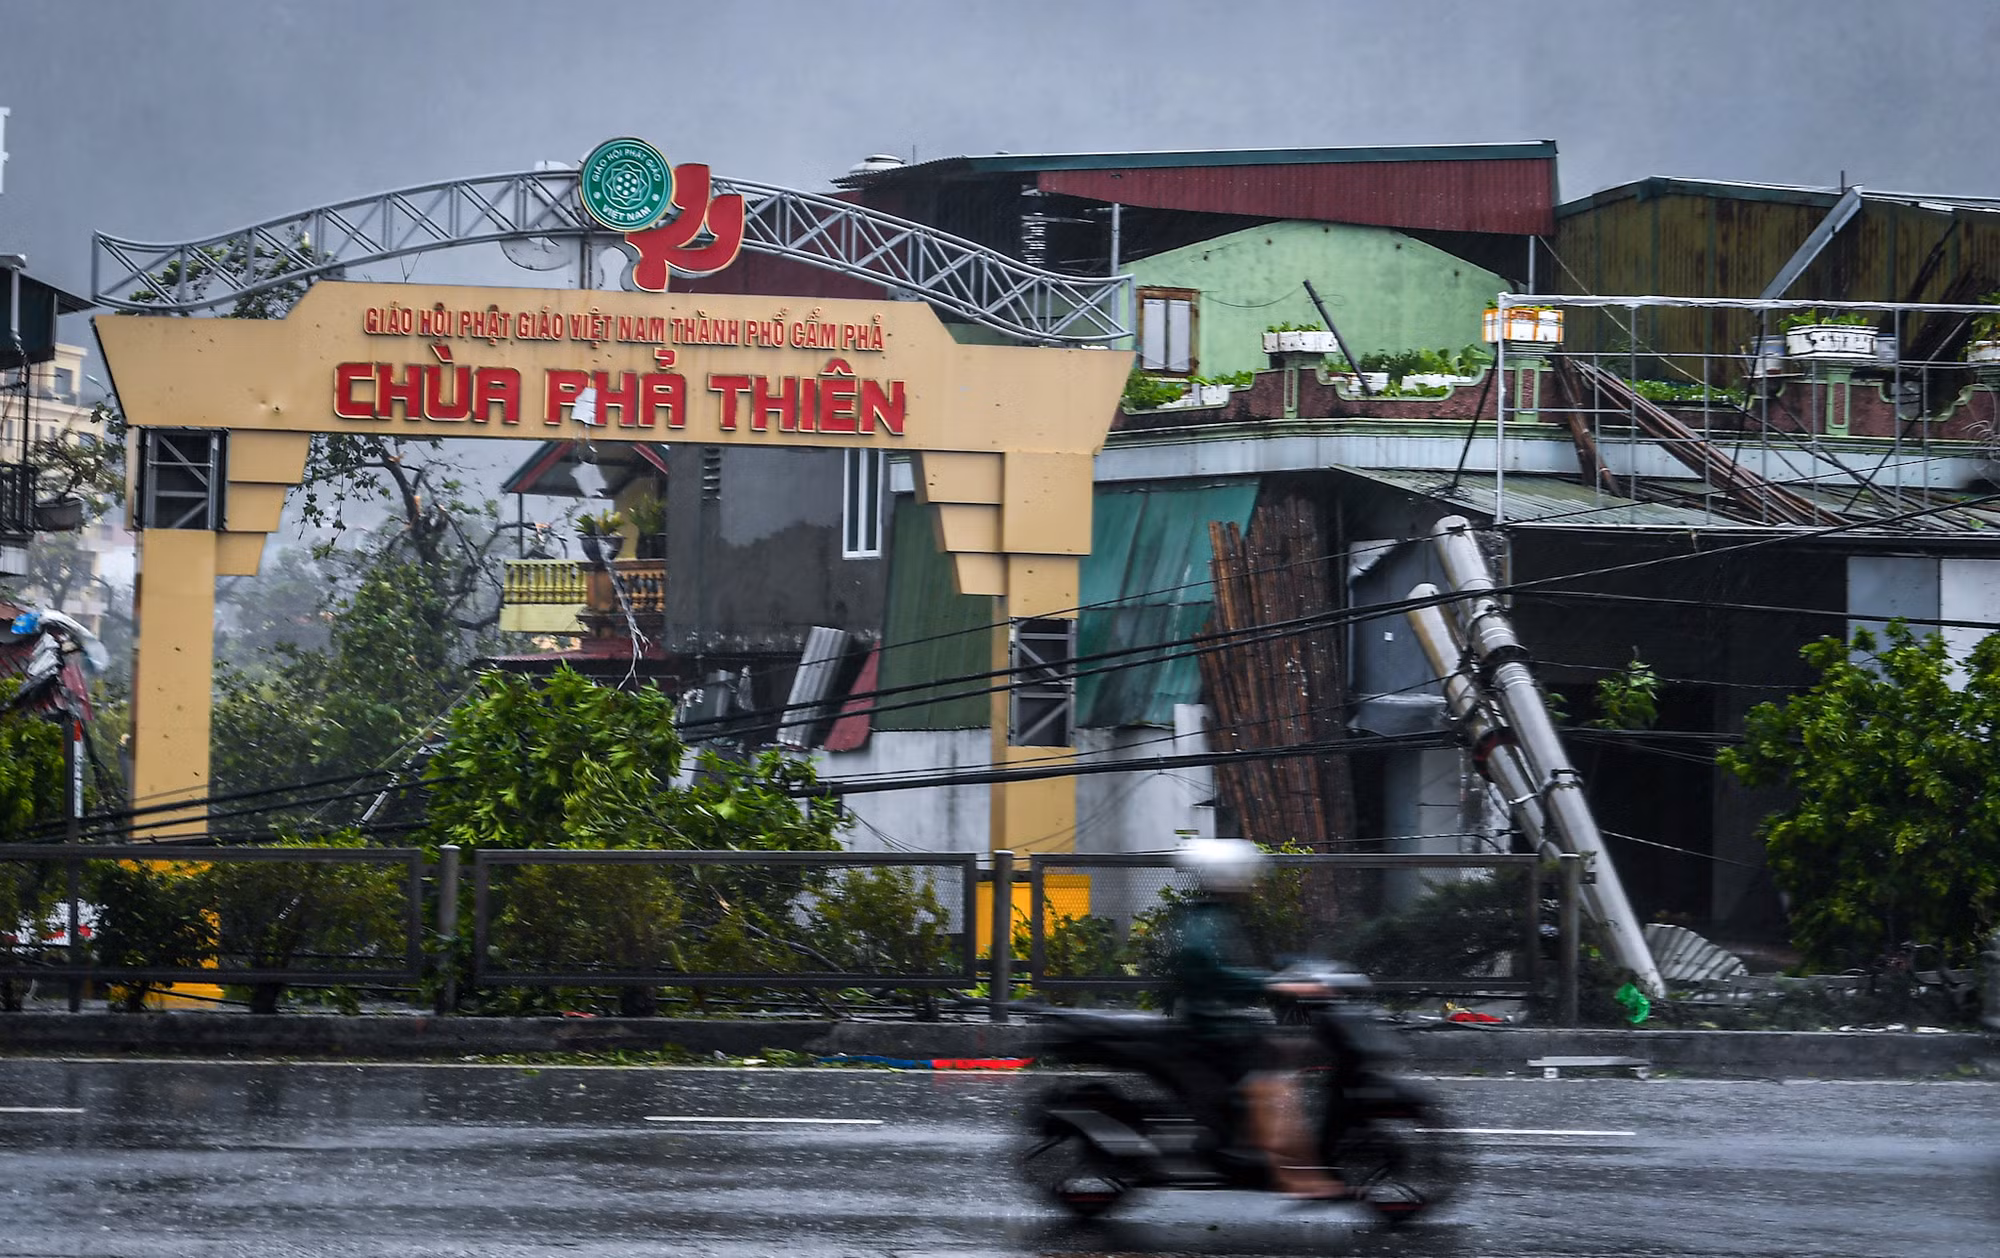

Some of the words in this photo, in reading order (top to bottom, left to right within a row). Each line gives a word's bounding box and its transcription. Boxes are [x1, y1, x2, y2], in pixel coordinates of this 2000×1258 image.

[626, 205, 652, 221] NAM
[364, 301, 412, 336] GIÁO
[457, 304, 511, 346] PHẬT
[516, 305, 564, 340] GIÁO
[569, 306, 612, 349] VIỆT
[616, 315, 666, 344] NAM
[670, 309, 740, 346] THÀNH
[744, 306, 789, 348] PHỐ
[790, 306, 837, 350] CẨM
[841, 312, 884, 351] PHẢ
[334, 343, 521, 424] CHÙA
[544, 347, 687, 429] PHẢ
[707, 357, 906, 435] THIÊN
